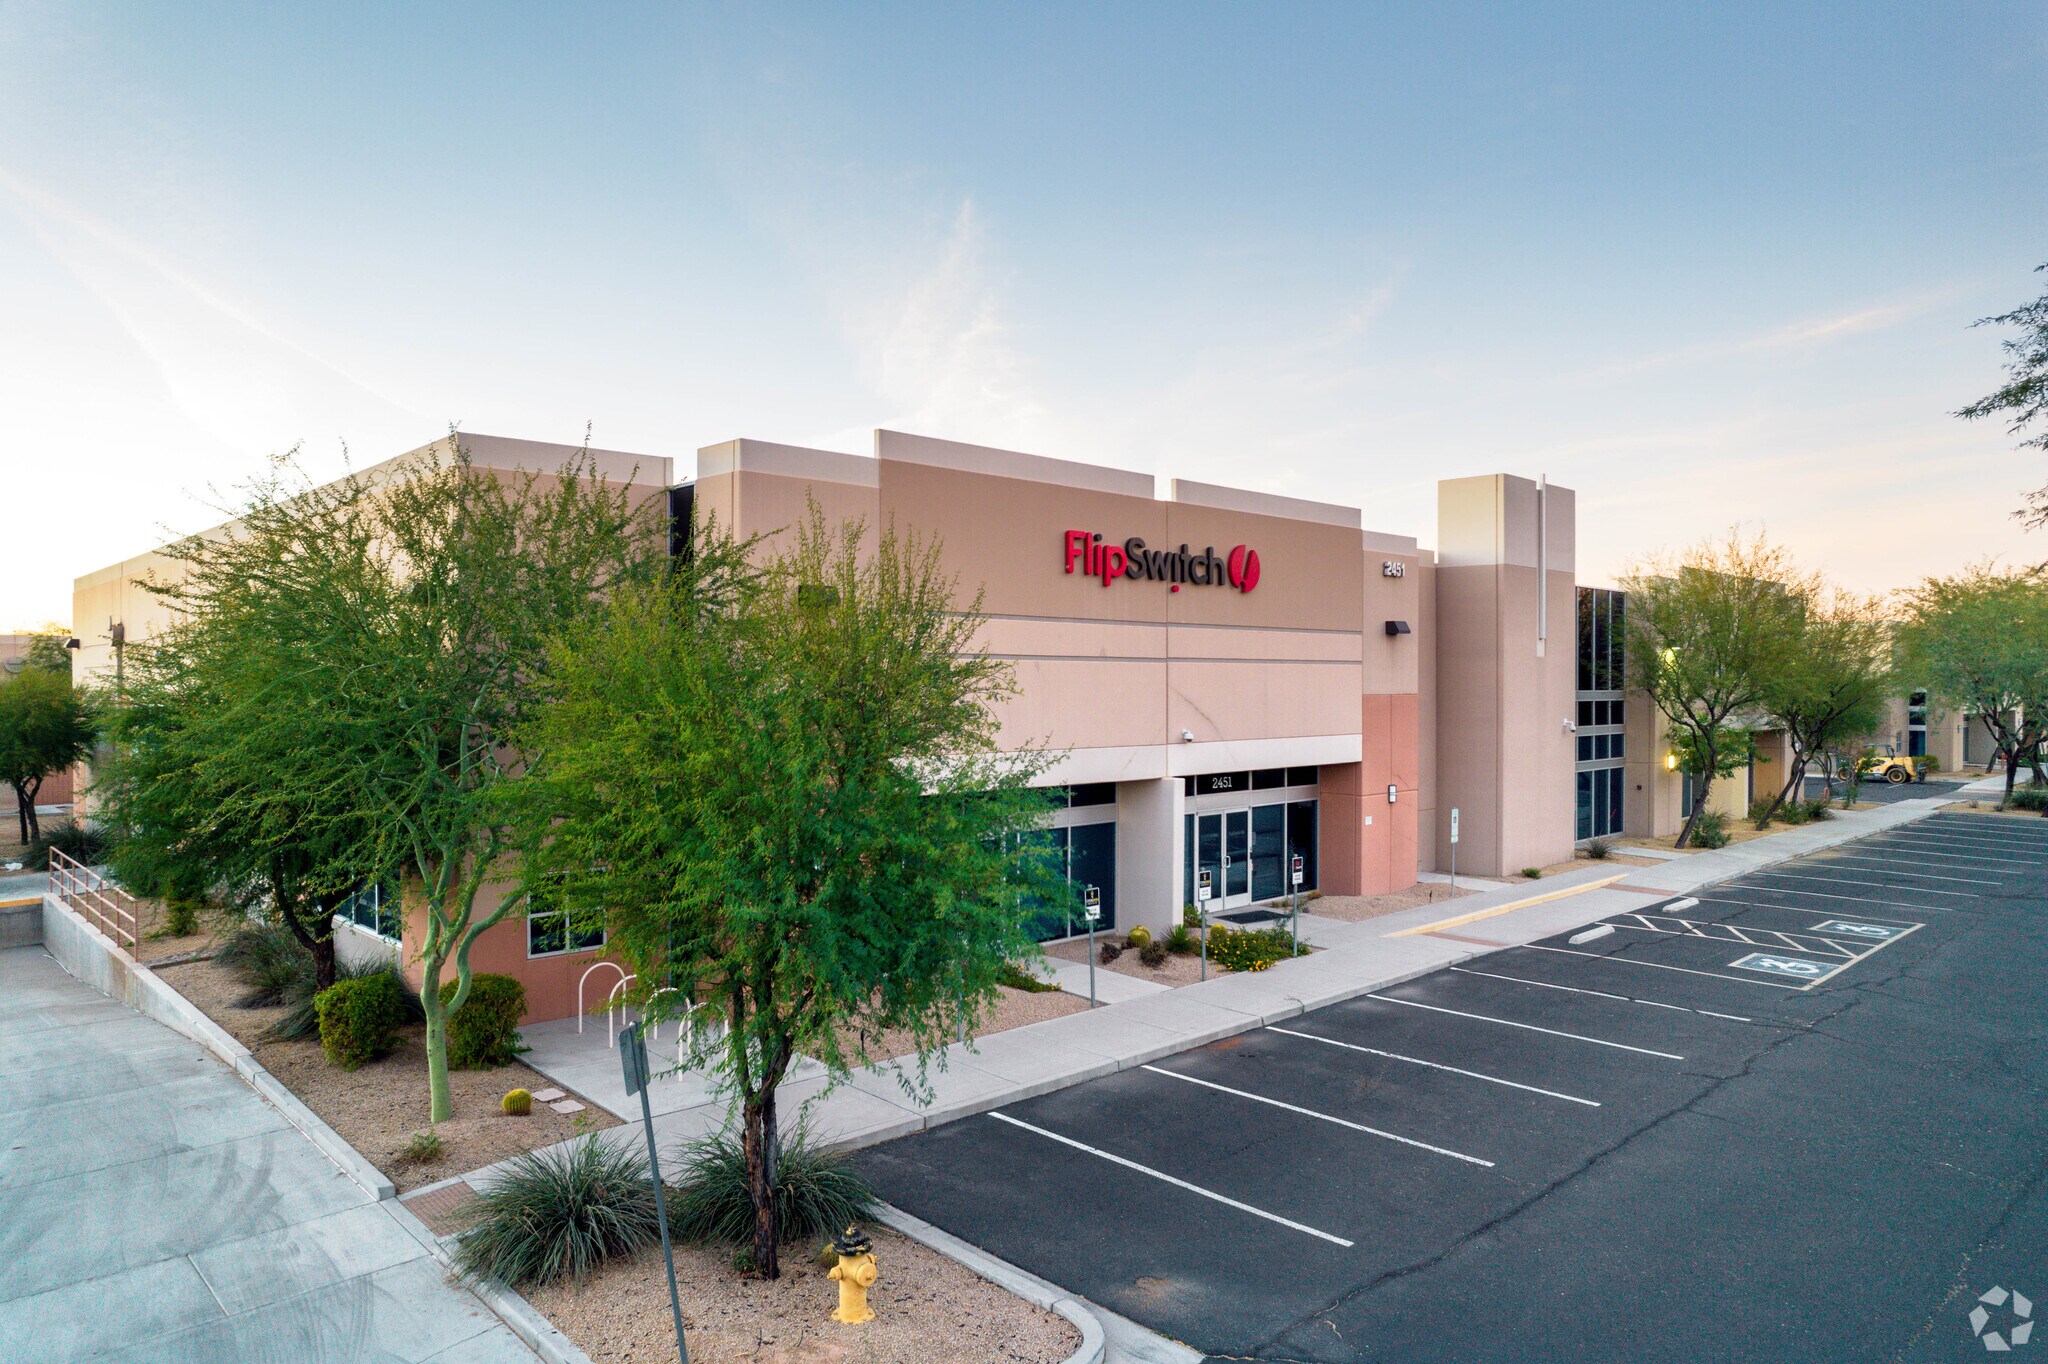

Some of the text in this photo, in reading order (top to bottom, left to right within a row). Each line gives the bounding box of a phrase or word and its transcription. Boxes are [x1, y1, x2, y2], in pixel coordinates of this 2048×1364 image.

[1065, 529, 1226, 593] FlipSwitch
[1383, 561, 1406, 578] 2451
[1212, 776, 1233, 789] 2451
